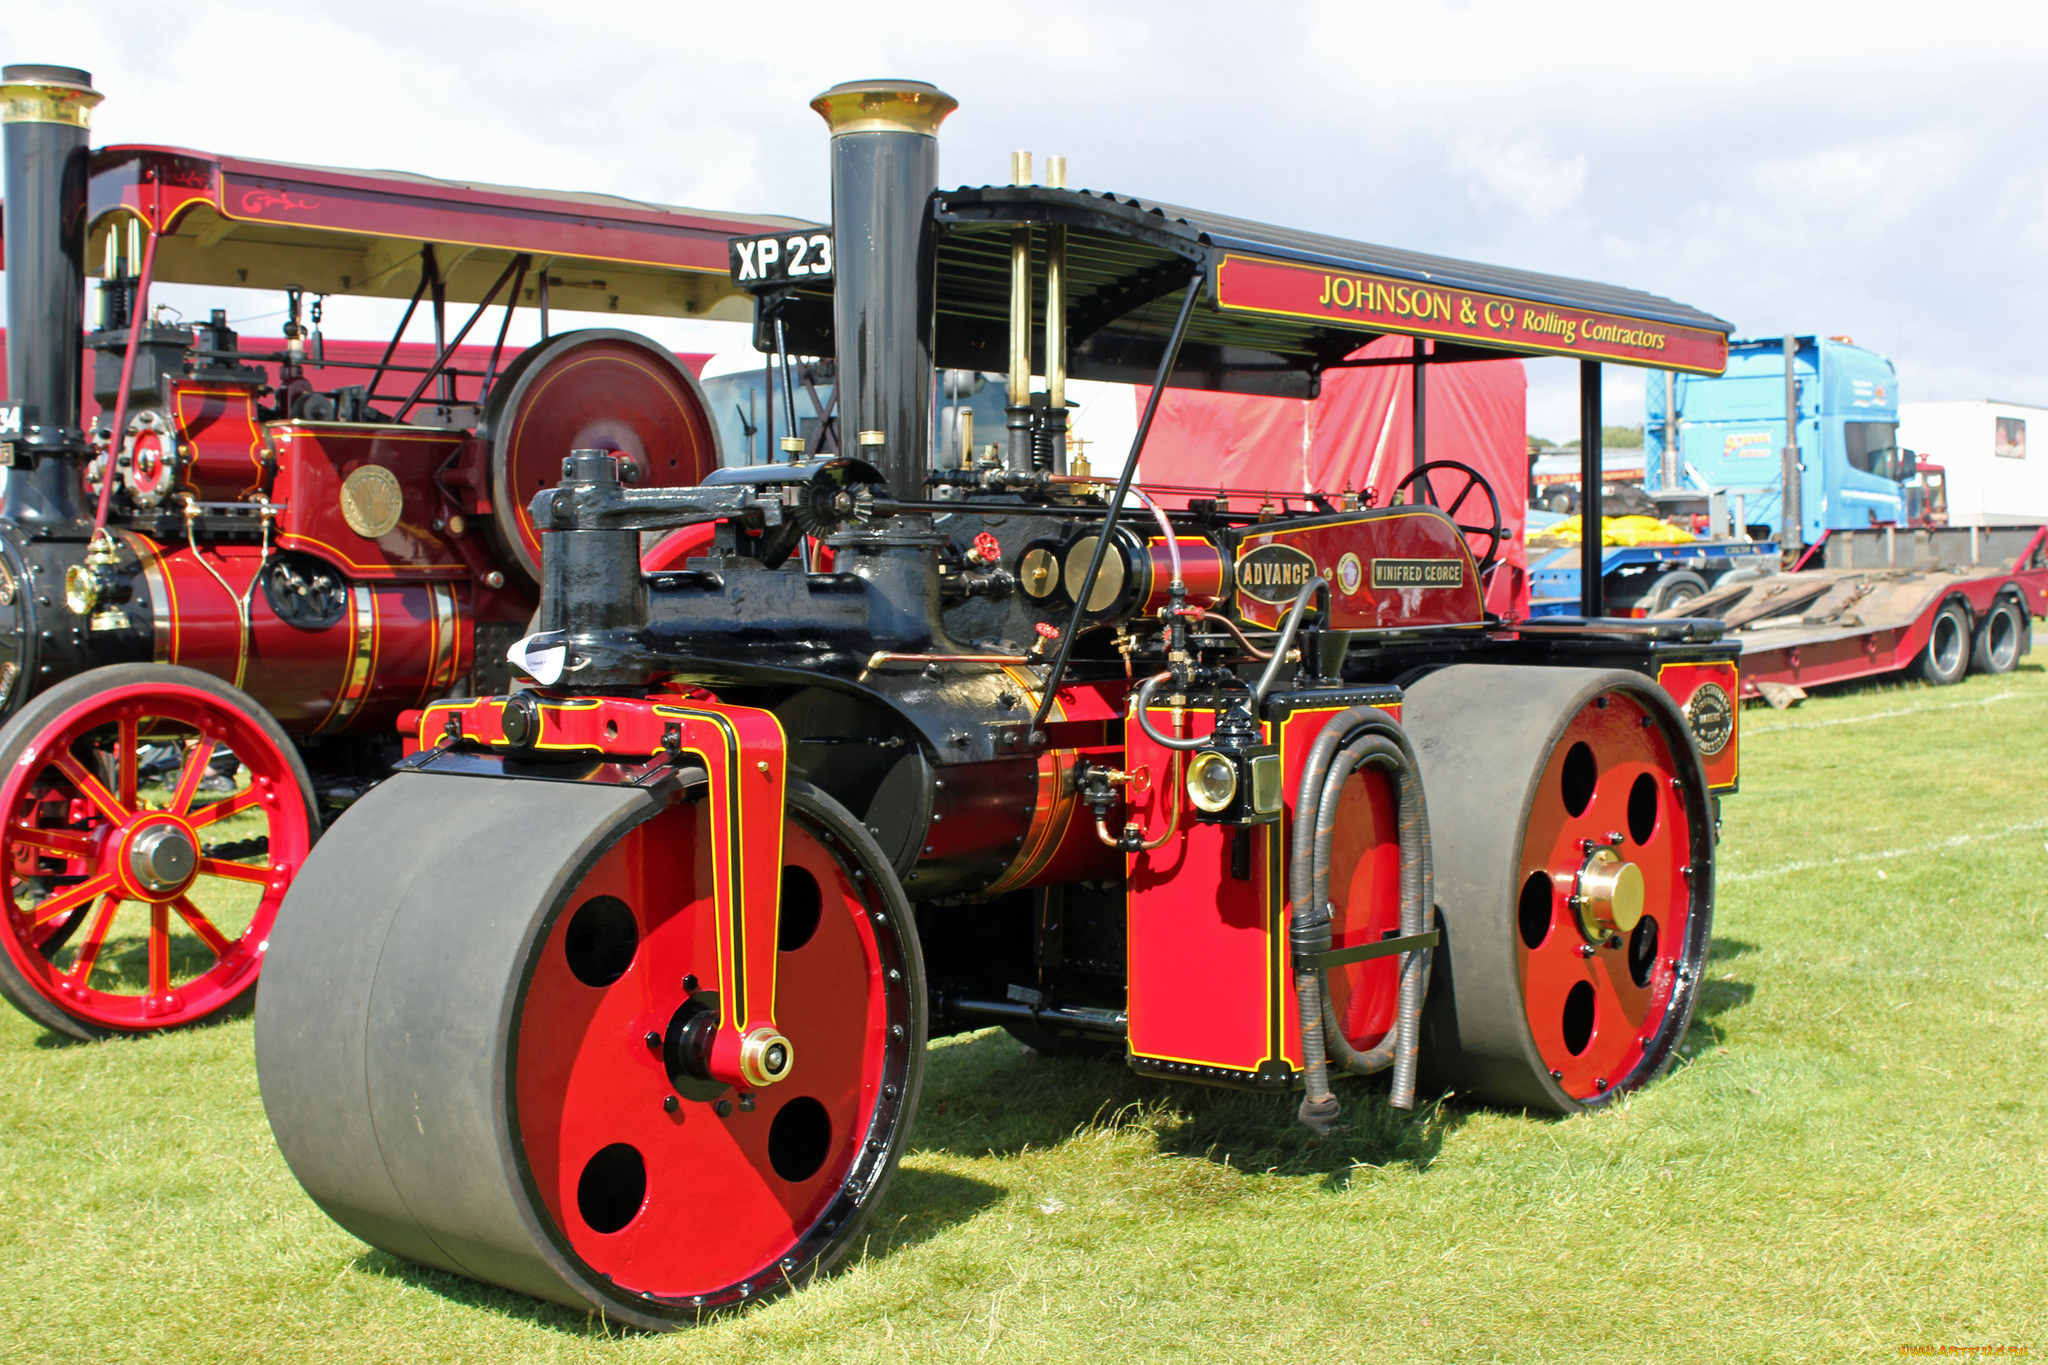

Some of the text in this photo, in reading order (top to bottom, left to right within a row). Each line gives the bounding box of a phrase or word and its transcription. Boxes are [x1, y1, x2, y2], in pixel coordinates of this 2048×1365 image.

[736, 234, 832, 281] XP 23
[1319, 275, 1451, 321] JOHNSON
[1459, 296, 1478, 325] &
[1522, 309, 1577, 344] Rolling
[1581, 318, 1666, 350] Contractors
[1242, 562, 1310, 585] ADVANCE
[1376, 565, 1460, 581] WINIFRED GEORGE
